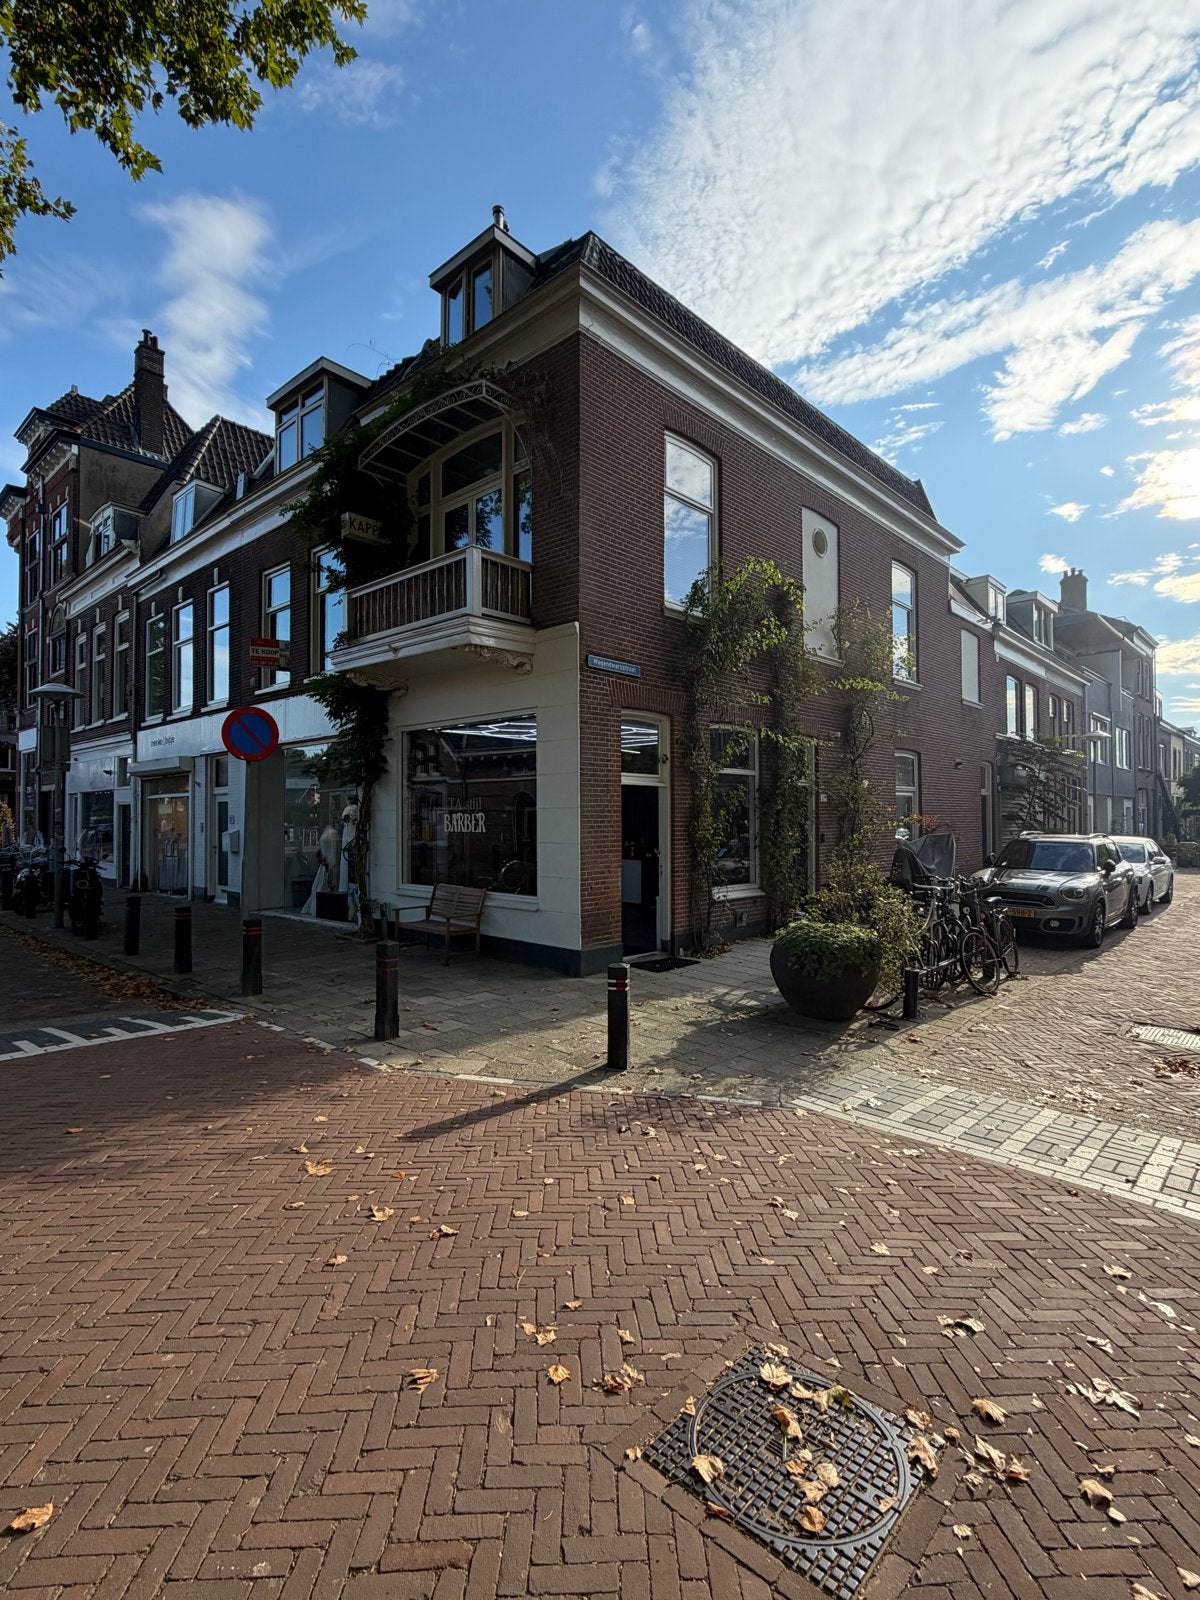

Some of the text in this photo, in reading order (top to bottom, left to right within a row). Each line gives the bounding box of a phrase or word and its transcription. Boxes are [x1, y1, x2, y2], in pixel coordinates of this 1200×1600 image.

[349, 516, 378, 536] KAPP
[251, 647, 279, 656] TE KOOP
[443, 812, 486, 833] BARBER
